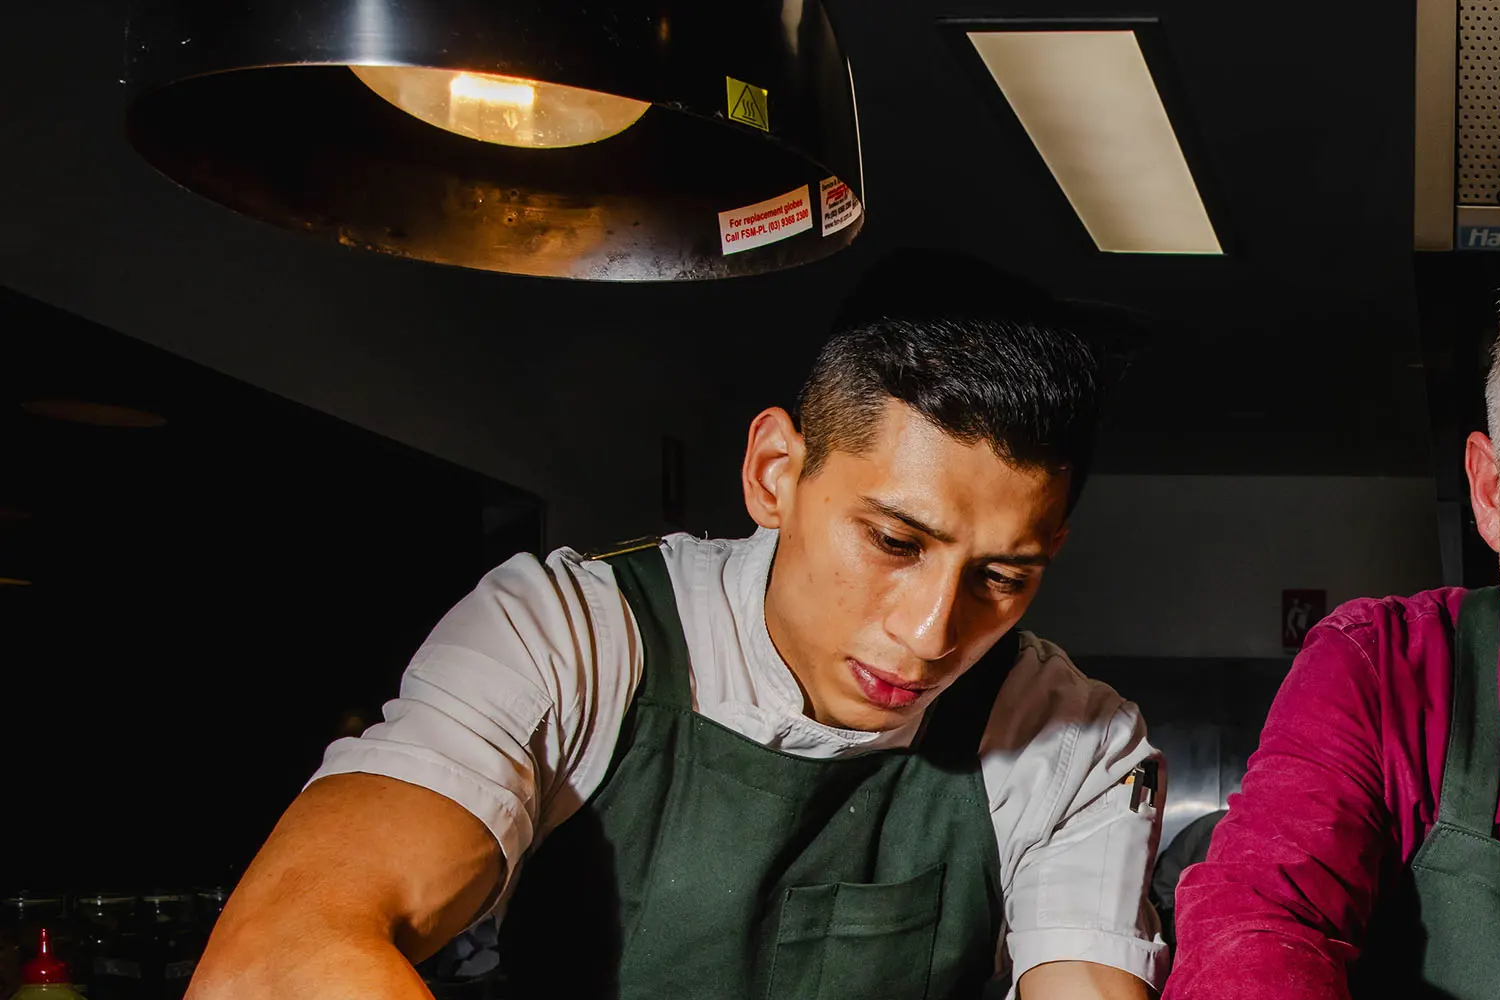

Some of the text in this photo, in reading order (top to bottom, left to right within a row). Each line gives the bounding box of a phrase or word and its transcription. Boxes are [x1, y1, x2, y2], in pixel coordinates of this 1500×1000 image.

[725, 231, 739, 243] Call
[741, 225, 768, 239] FSM-PL
[768, 221, 780, 234] (03)
[796, 208, 809, 222] 2300
[729, 199, 803, 228] For replacement globes
